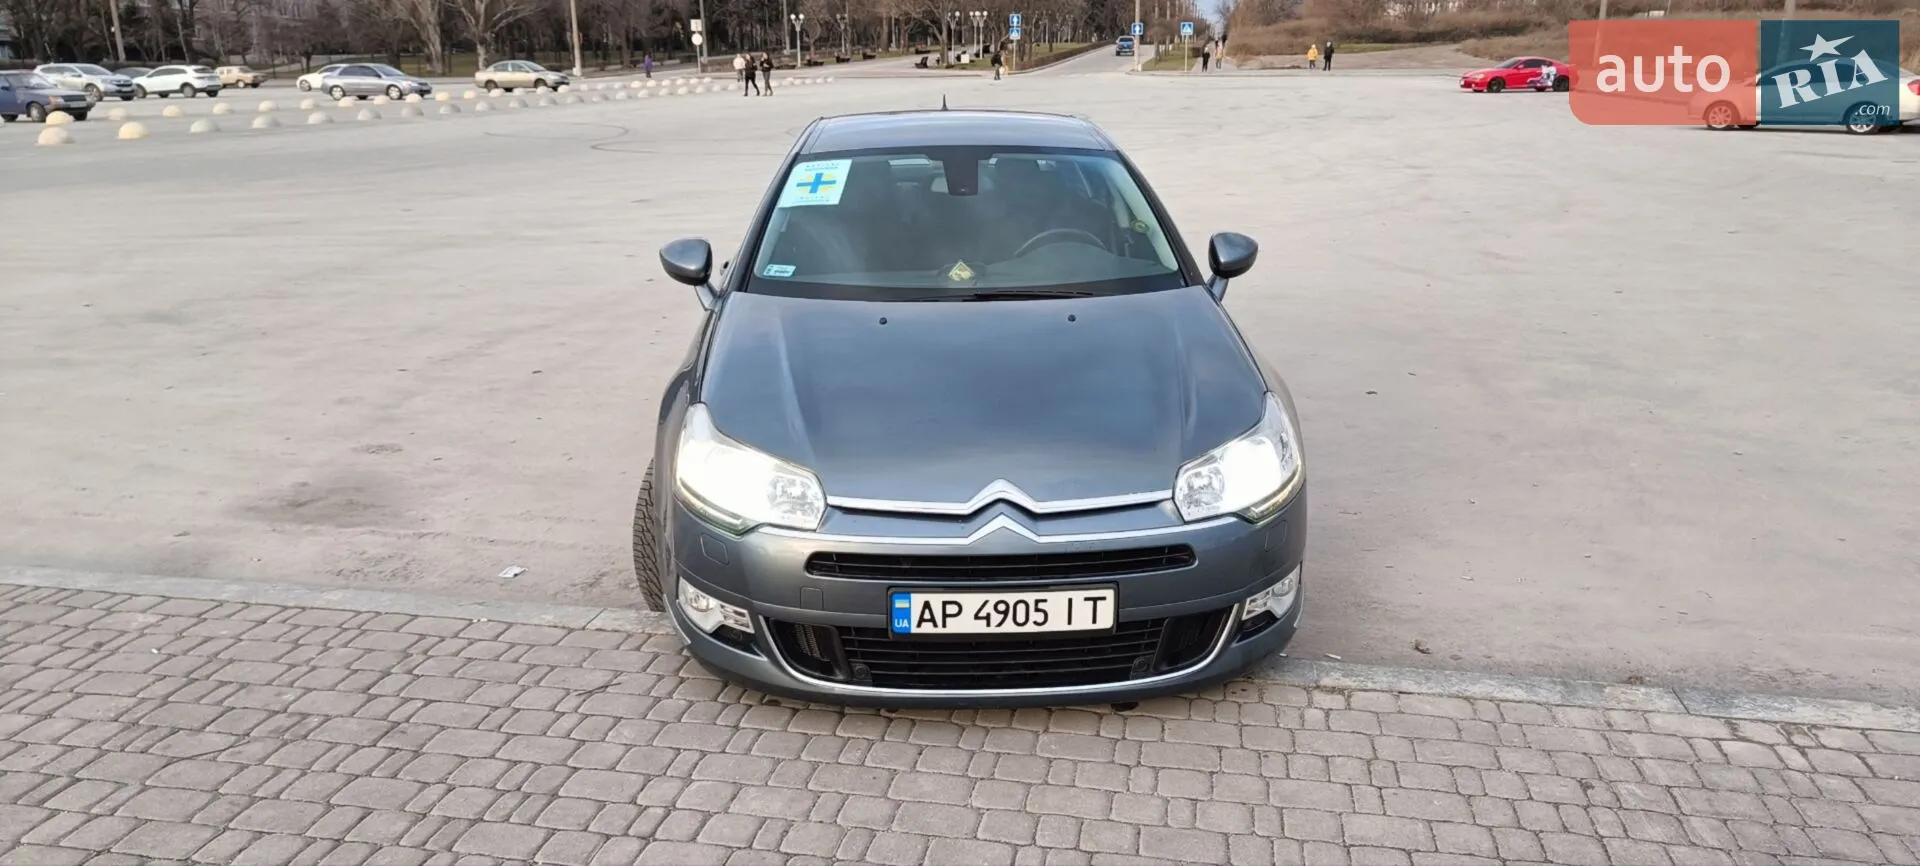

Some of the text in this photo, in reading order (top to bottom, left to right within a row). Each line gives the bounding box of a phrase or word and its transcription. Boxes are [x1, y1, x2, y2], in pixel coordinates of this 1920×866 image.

[895, 618, 909, 628] UA
[916, 599, 963, 629] AP
[973, 598, 1049, 628] 4905
